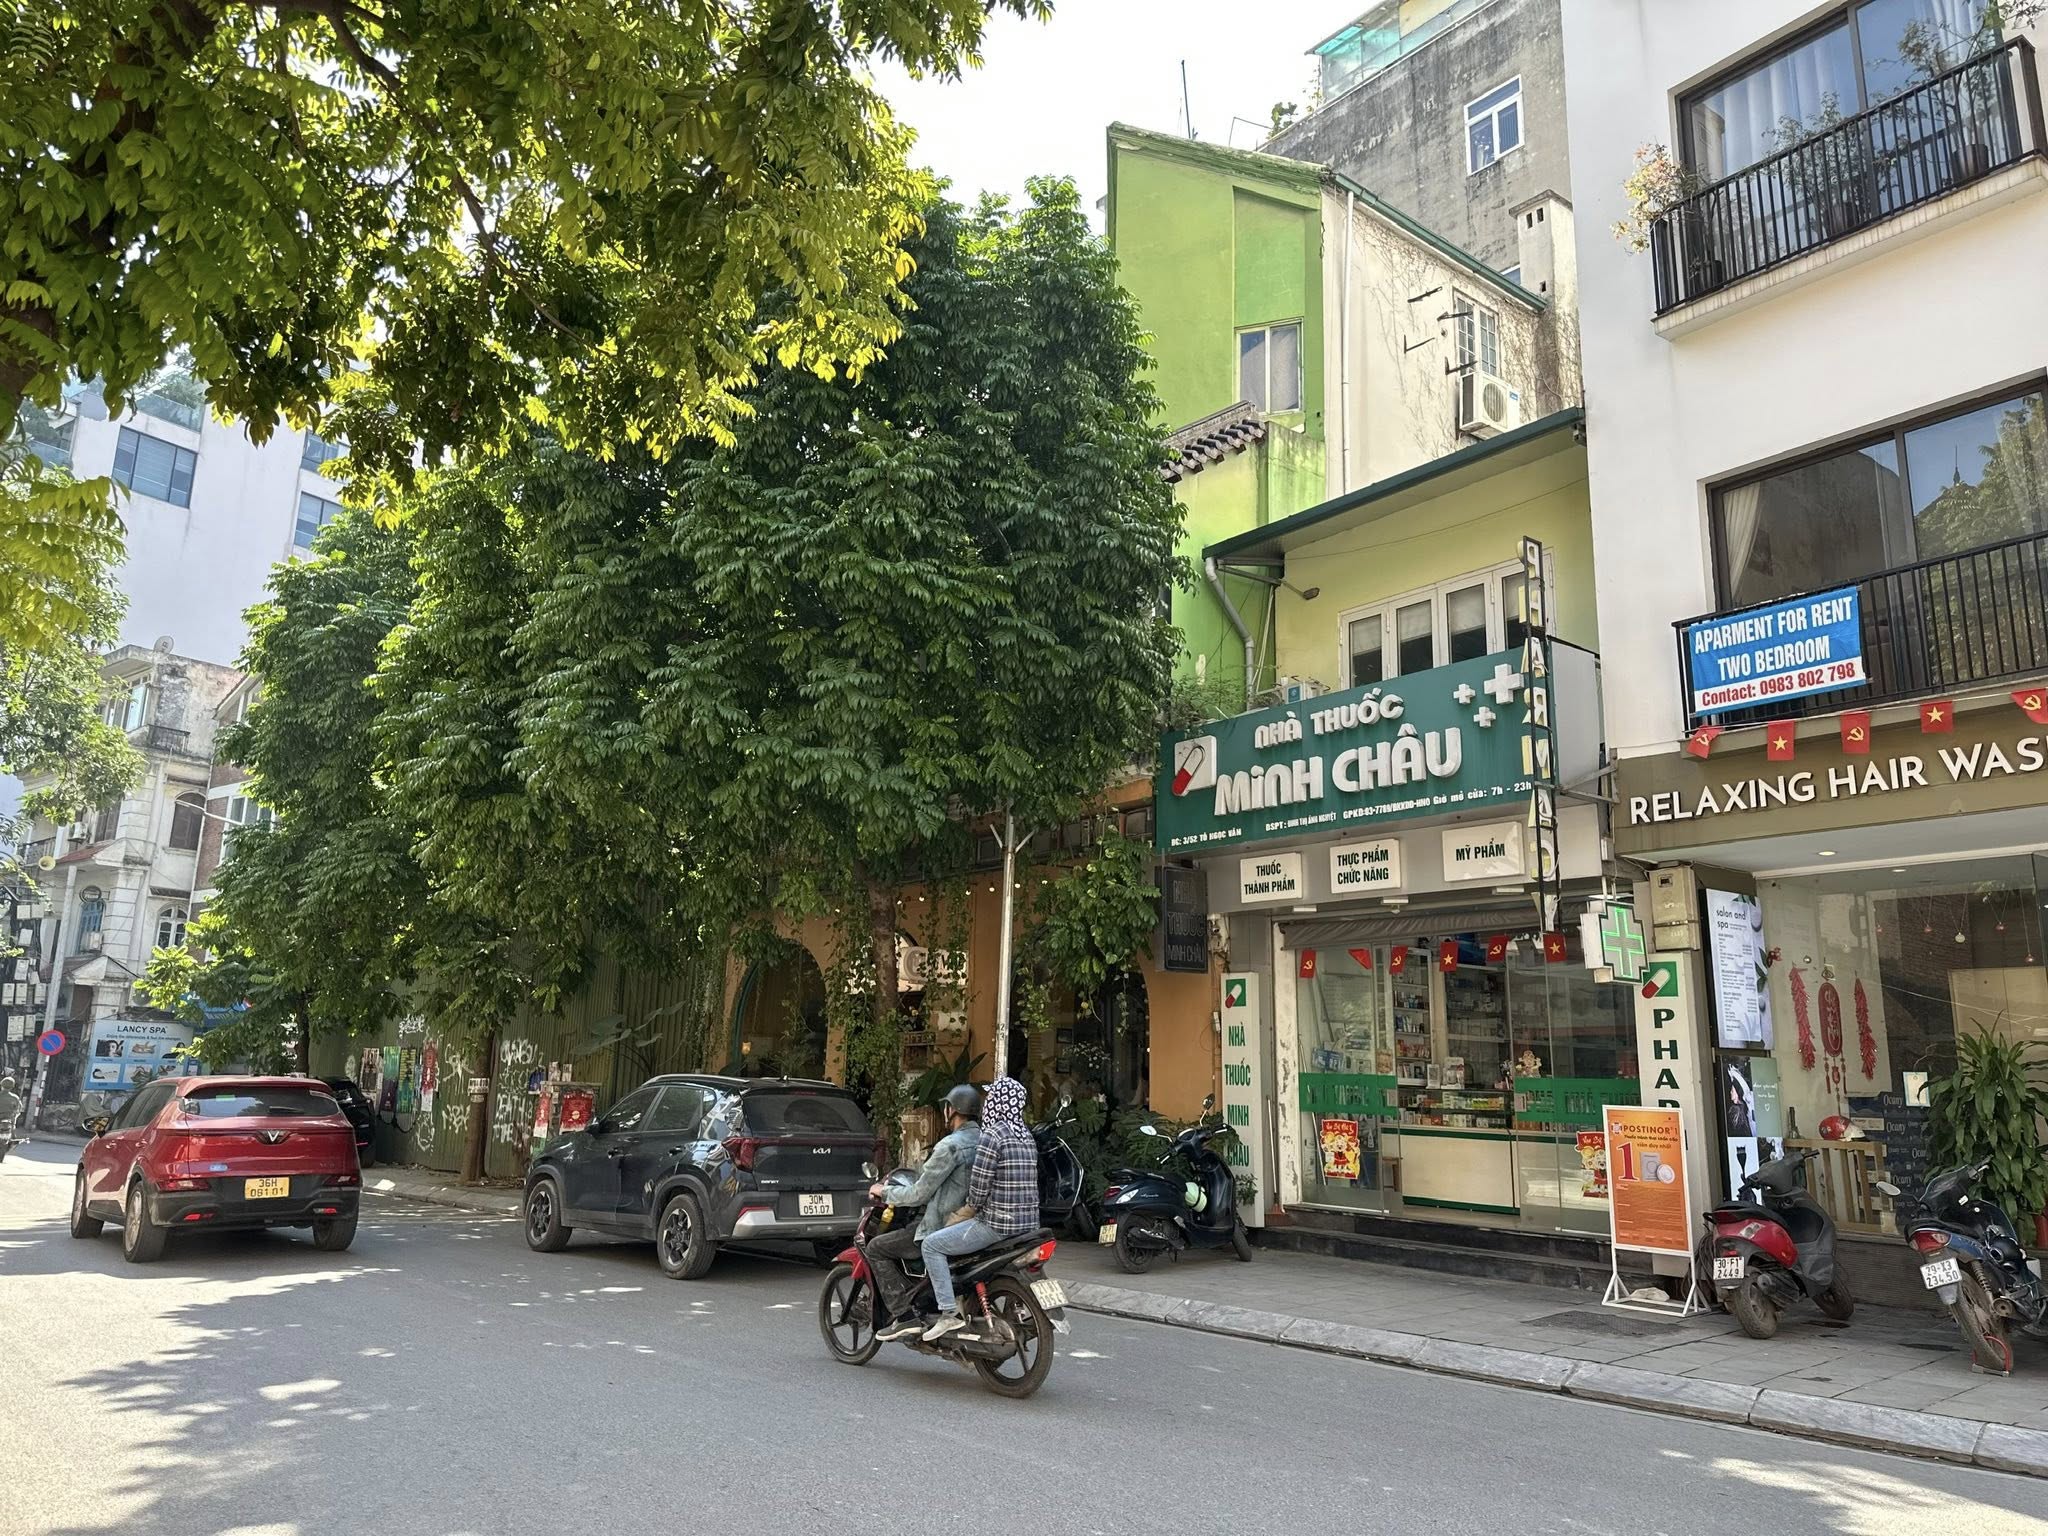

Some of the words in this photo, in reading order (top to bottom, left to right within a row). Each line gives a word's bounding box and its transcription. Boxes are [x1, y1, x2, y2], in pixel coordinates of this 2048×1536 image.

[1694, 613, 1774, 654] APARMENT
[1778, 605, 1808, 635] FOR
[1811, 597, 1853, 628] RENT
[1717, 654, 1751, 682] TWO
[1755, 636, 1831, 671] BEDROOM
[1701, 682, 1757, 707] Contact:
[1760, 674, 1794, 697] 0983
[1797, 667, 1825, 689] 802
[1827, 661, 1856, 682] 798
[1311, 688, 1404, 735] THUỐC
[1331, 723, 1462, 793] CHÂU
[1491, 785, 1503, 796] 7h
[1514, 780, 1532, 792] 23h
[1630, 771, 1815, 825] RELAXING
[1828, 754, 1929, 799] HAIR
[1937, 735, 2048, 783] WAS
[1337, 851, 1360, 870] THỰC
[1362, 844, 1389, 863] PHẨM
[1455, 844, 1472, 861] MỸ
[1474, 837, 1506, 859] PHẨM
[1256, 859, 1282, 877] THUỐC
[1337, 867, 1361, 885] CHỨC
[1363, 865, 1389, 882] NĂNG
[1244, 879, 1270, 896] THÀNH
[1271, 876, 1295, 893] PHẨM
[1716, 906, 1733, 918] salon
[1734, 910, 1746, 920] and
[1717, 921, 1728, 930] spa
[117, 1025, 147, 1033] LANCY
[149, 1026, 166, 1034] SPA
[1228, 1021, 1246, 1048] NHÀ
[1224, 1058, 1251, 1087] THUỐC
[1227, 1103, 1250, 1127] MINH
[1617, 1142, 1639, 1181] 1
[259, 1178, 277, 1188] 36H
[803, 1205, 830, 1215] 051.07
[1717, 1269, 1739, 1278] 2449
[1926, 1270, 1959, 1288] 234.50
